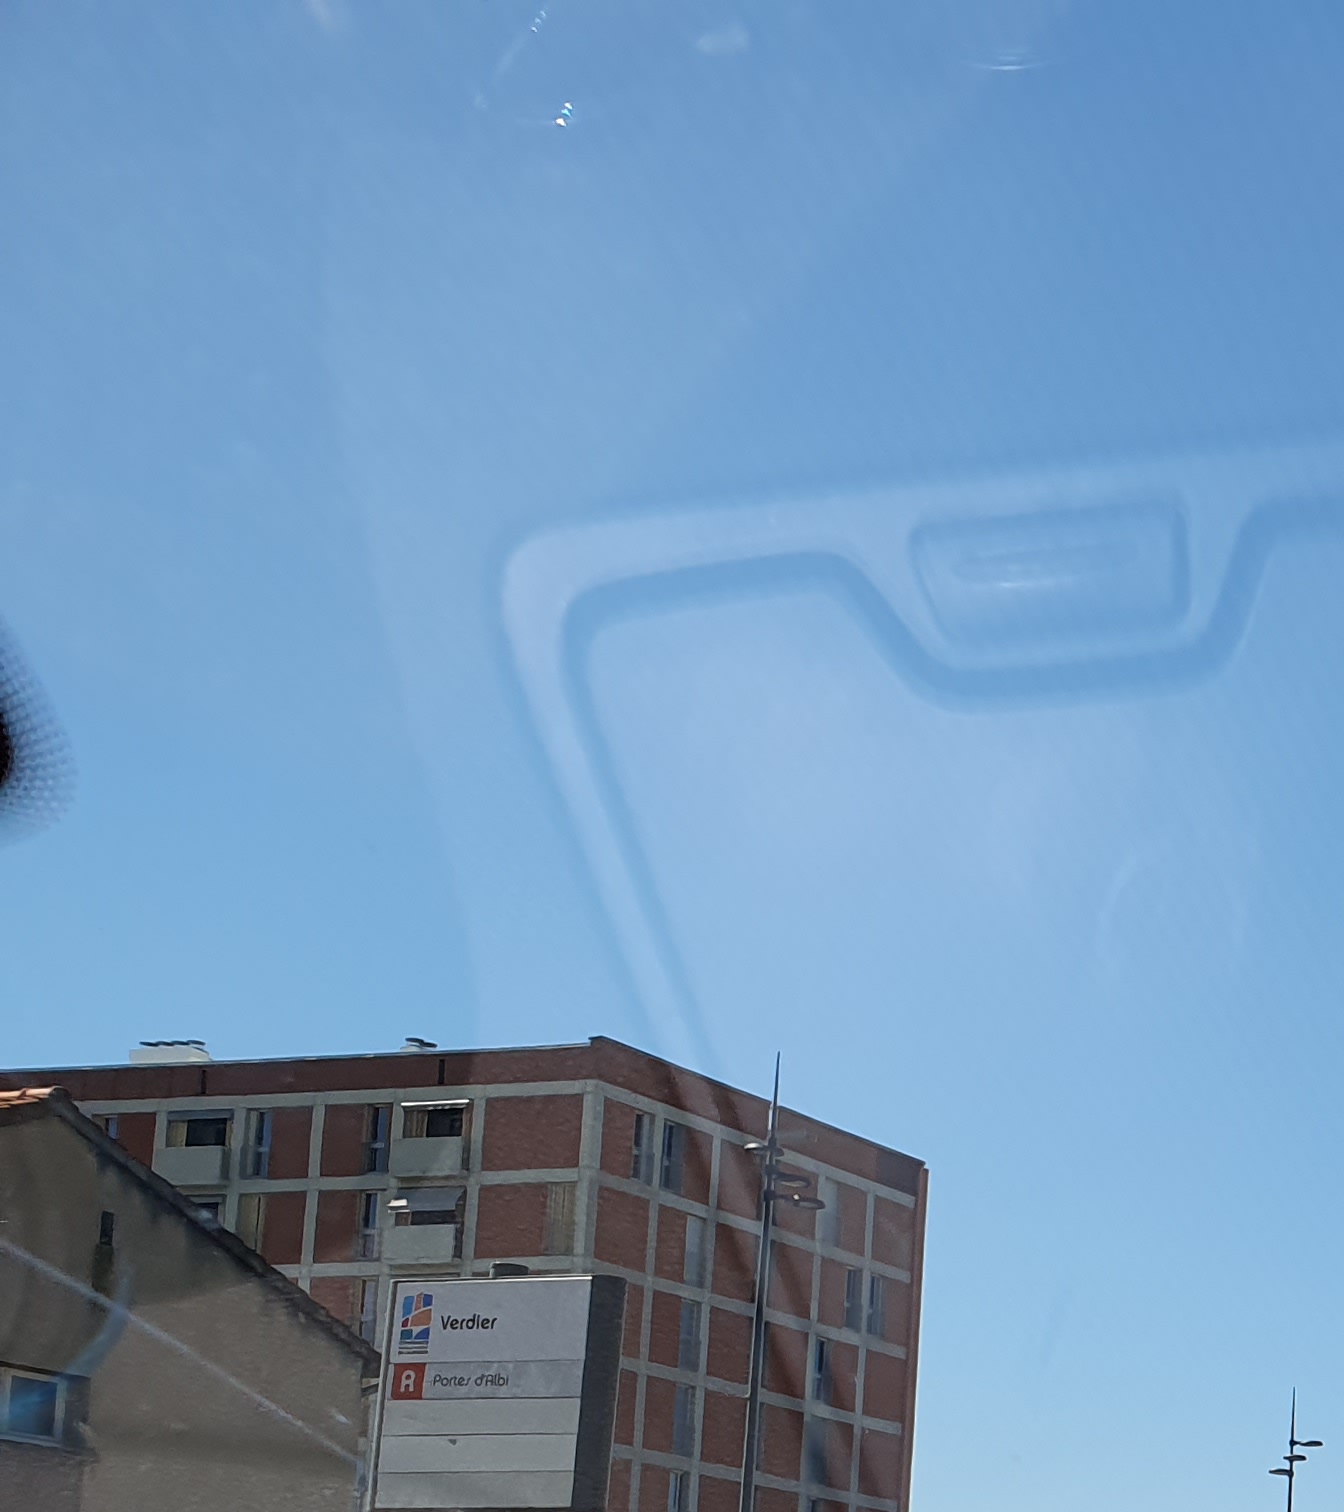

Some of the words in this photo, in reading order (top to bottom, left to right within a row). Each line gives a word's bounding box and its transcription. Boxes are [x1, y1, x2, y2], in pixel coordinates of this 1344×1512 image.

[440, 1313, 498, 1331] Verdier
[400, 1369, 416, 1393] A
[433, 1374, 471, 1387] Portes
[474, 1373, 509, 1387] d'Albi
